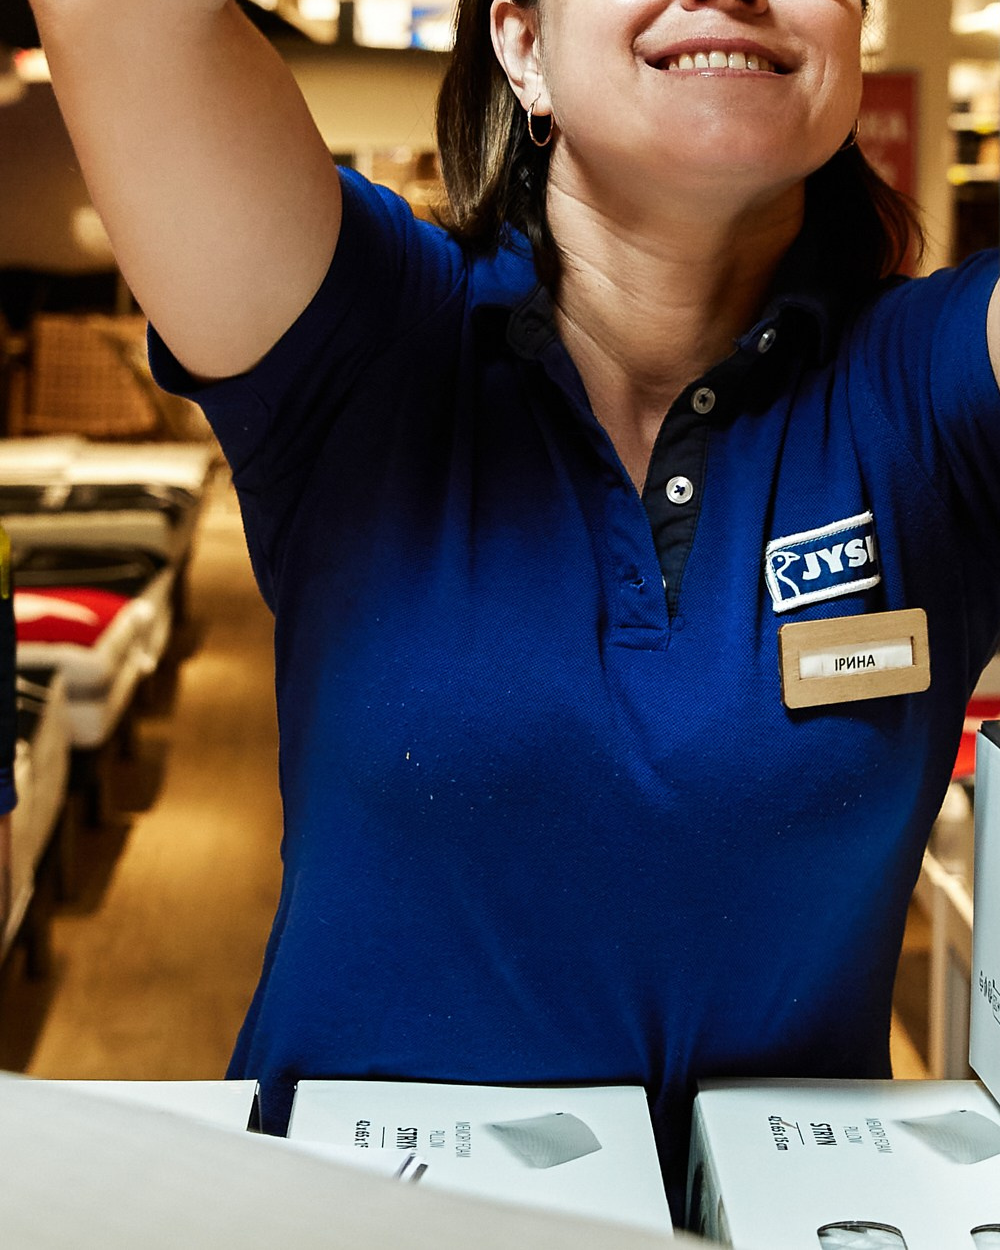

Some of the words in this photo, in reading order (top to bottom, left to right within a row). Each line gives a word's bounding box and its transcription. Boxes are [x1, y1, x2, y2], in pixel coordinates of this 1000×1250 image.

[834, 654, 876, 672] ІРИНА
[455, 1121, 471, 1142] MEMORY
[810, 1123, 837, 1145] STRYN
[843, 1126, 863, 1144] PILLOW
[865, 1118, 886, 1138] MEMORY
[429, 1130, 446, 1148] PILLOW
[873, 1138, 894, 1154] FOAM
[455, 1143, 471, 1158] FOAM
